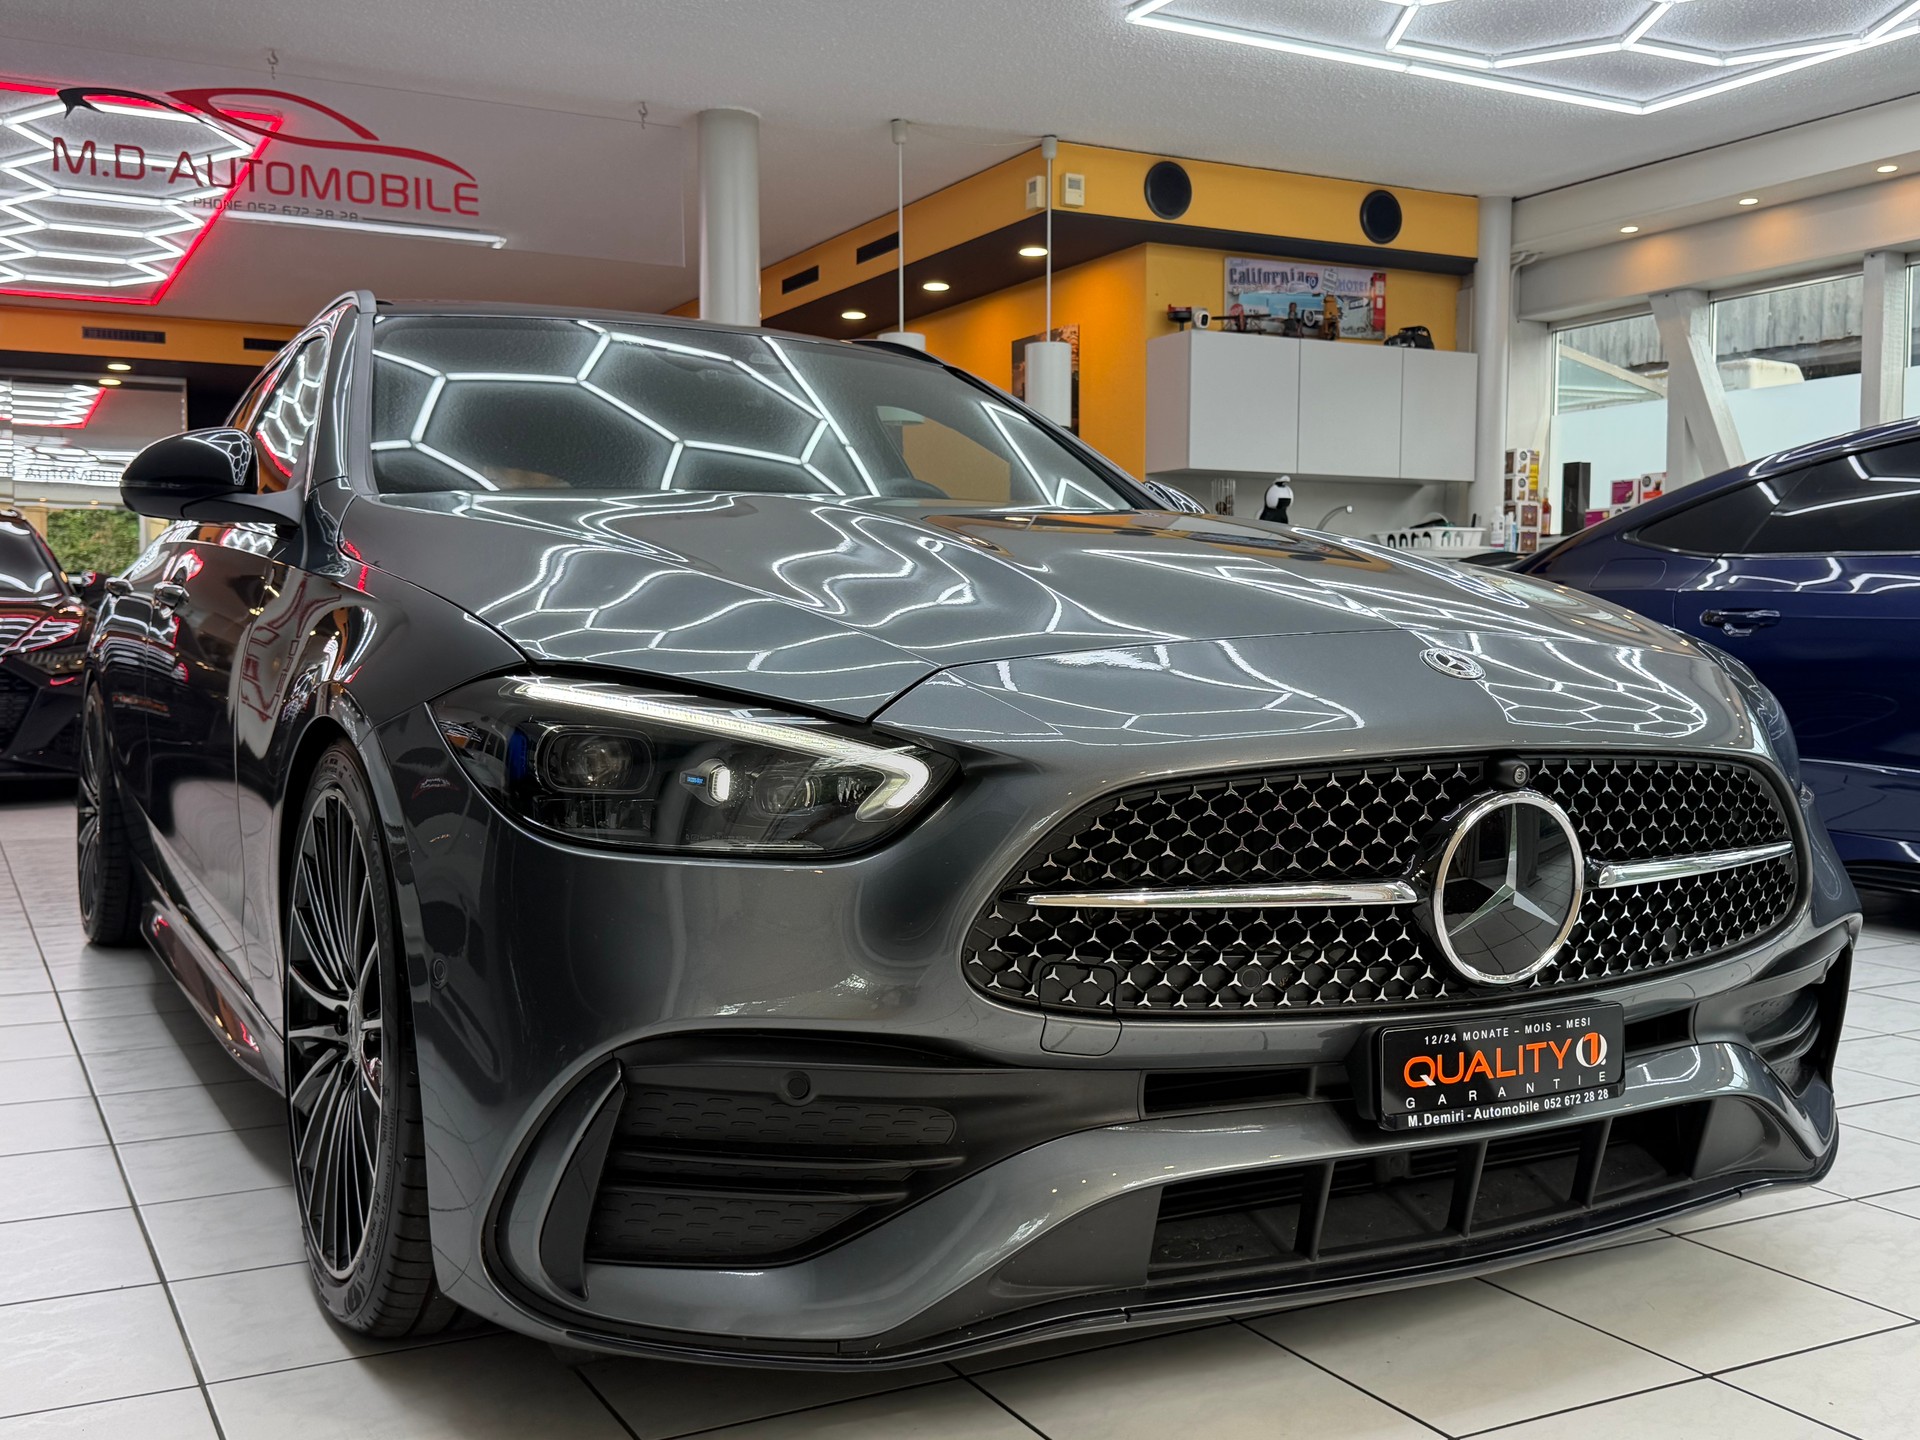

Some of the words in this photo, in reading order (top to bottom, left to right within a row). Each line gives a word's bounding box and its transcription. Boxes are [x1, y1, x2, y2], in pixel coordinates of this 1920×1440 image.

[52, 136, 480, 216] M.D-AUTOMOBILE
[193, 197, 242, 211] PHONE
[247, 201, 276, 213] 052
[282, 205, 309, 216] 672
[1229, 267, 1305, 285] California
[1424, 1034, 1457, 1046] 12/24
[1462, 1027, 1510, 1042] MONATE
[1524, 1022, 1552, 1035] MOIS
[1566, 1017, 1591, 1029] MESI
[1403, 1038, 1573, 1089] QUALITY
[1405, 1071, 1606, 1110] GARANTIE
[1473, 1101, 1540, 1120] Automobile
[1544, 1096, 1562, 1109] 052
[1564, 1093, 1582, 1106] 672
[1583, 1091, 1596, 1103] 28
[1597, 1088, 1609, 1100] 28
